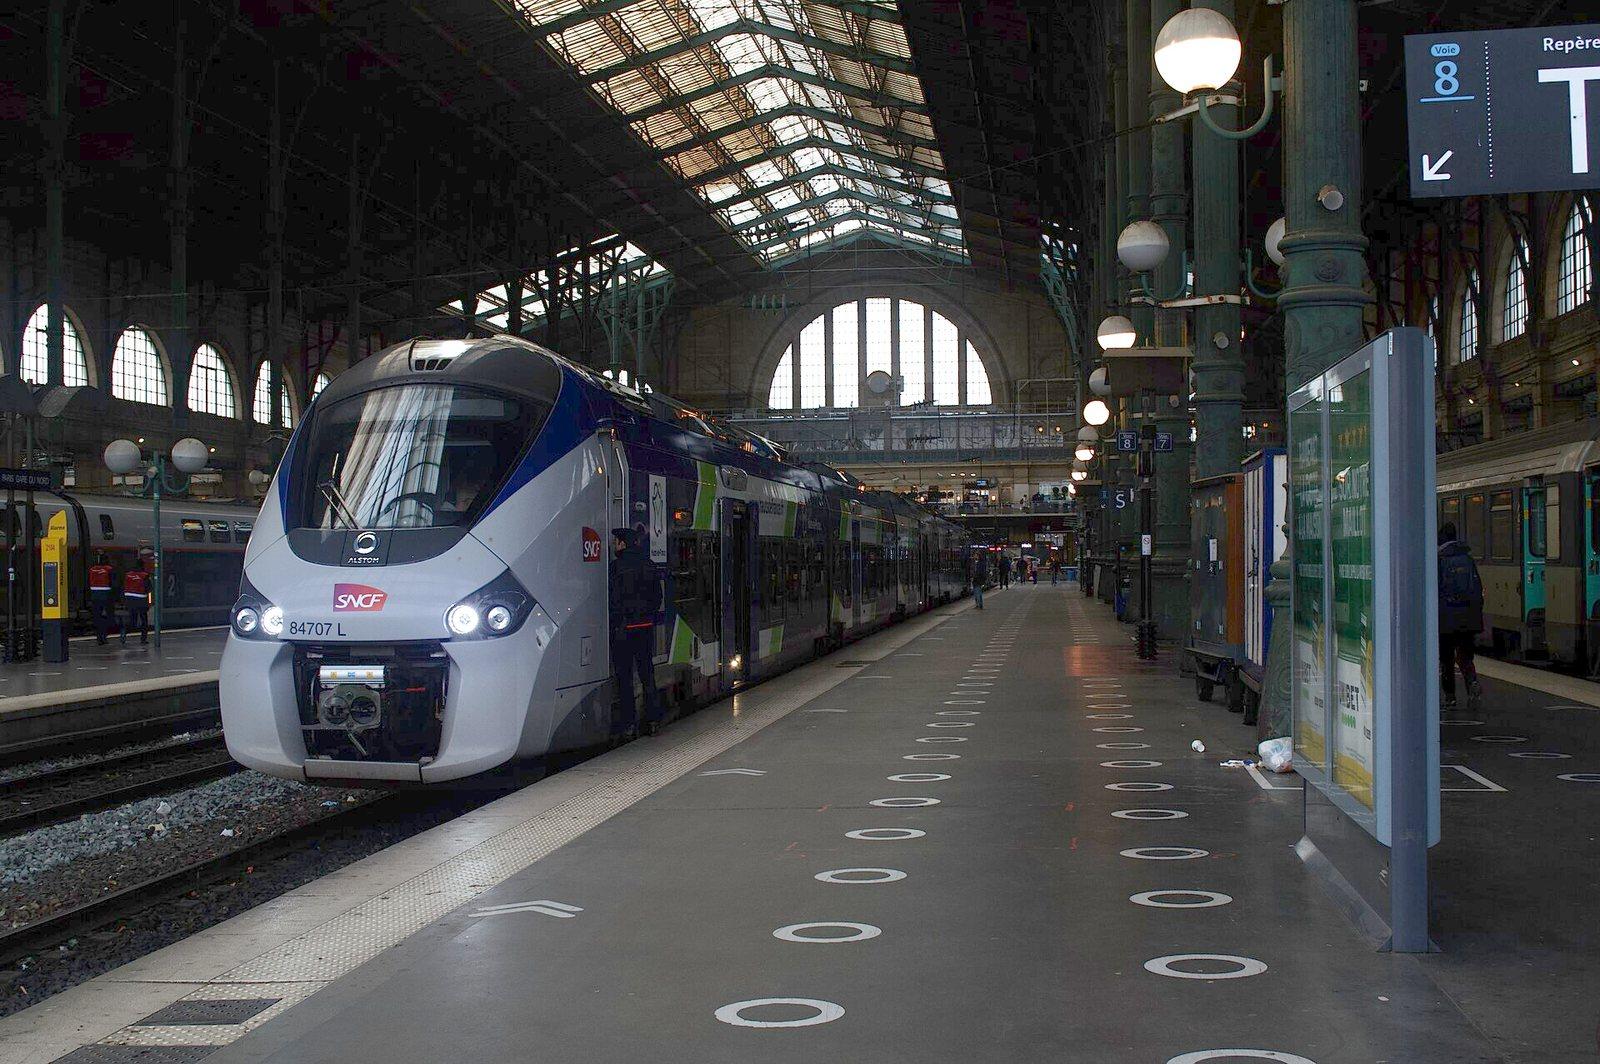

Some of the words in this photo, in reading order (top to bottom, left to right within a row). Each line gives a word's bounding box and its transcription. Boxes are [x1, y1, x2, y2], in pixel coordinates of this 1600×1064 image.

[1434, 45, 1456, 54] Voie
[1543, 36, 1600, 54] Repère
[1434, 60, 1460, 96] 8
[1537, 66, 1600, 174] T
[1123, 439, 1131, 449] 8
[1159, 439, 1167, 449] 7
[1116, 493, 1125, 508] S
[583, 540, 600, 558] SNCF
[335, 593, 384, 608] SNCF
[289, 621, 332, 636] 84707
[337, 622, 347, 636] L
